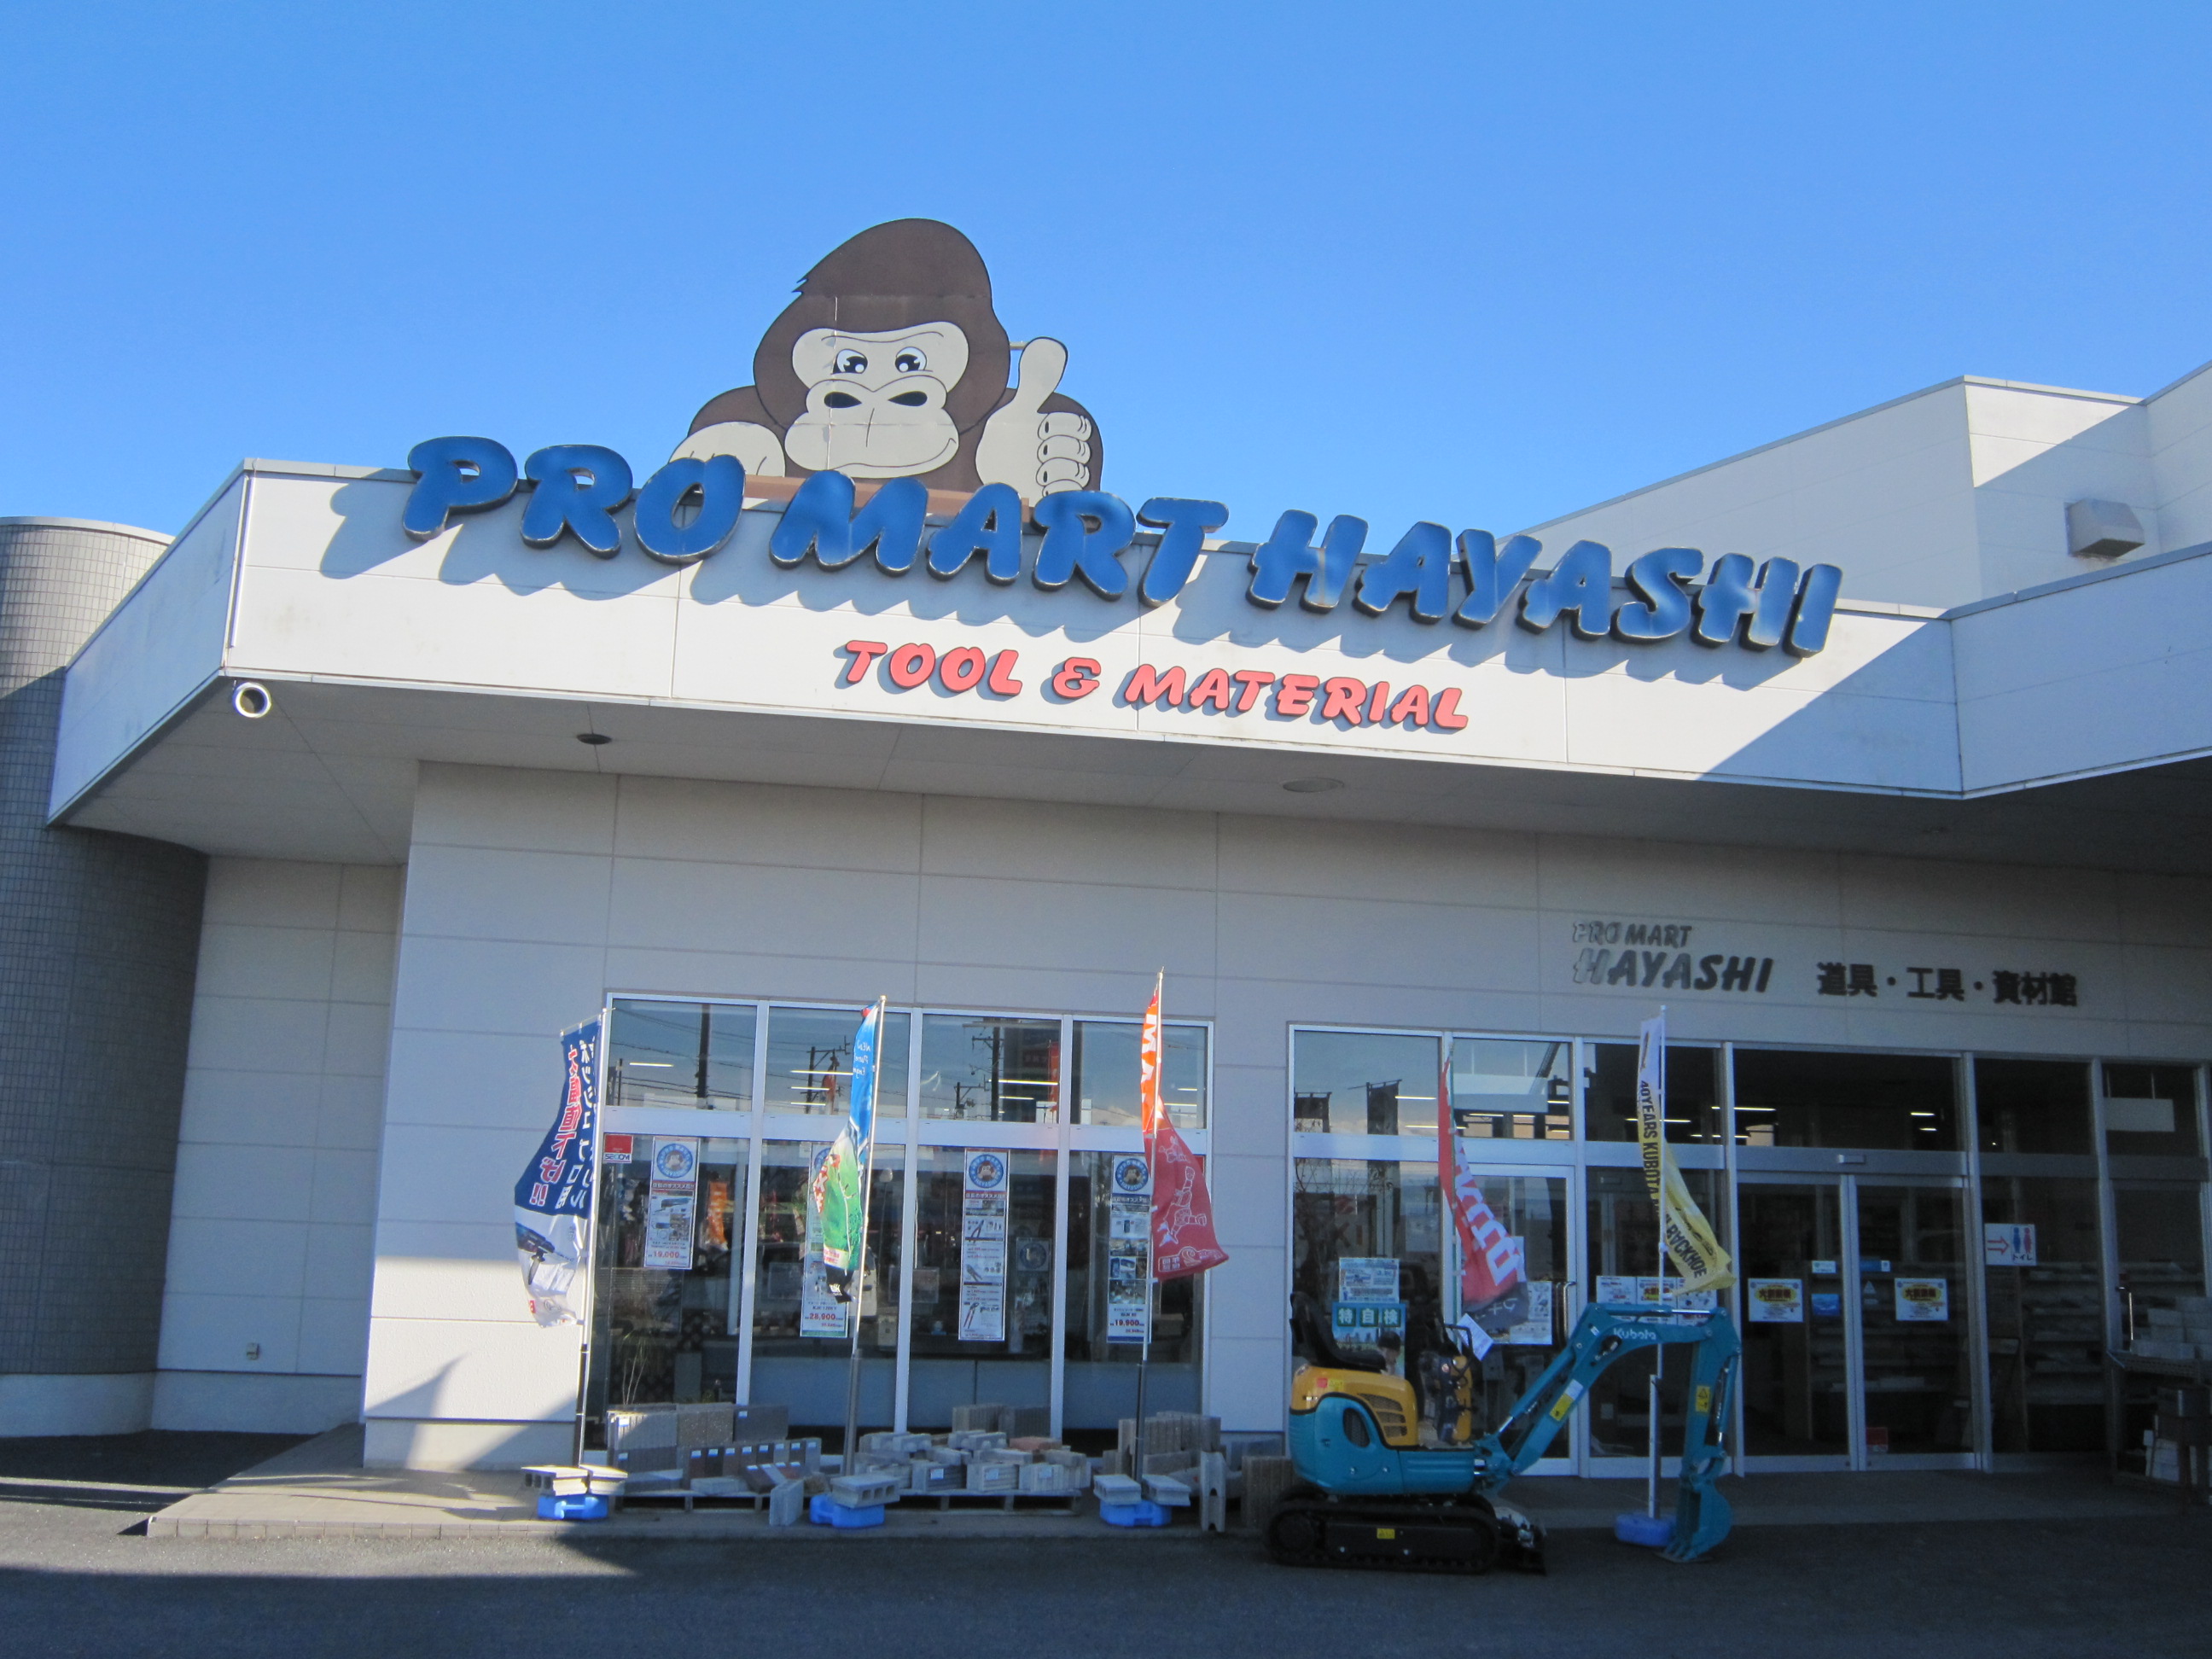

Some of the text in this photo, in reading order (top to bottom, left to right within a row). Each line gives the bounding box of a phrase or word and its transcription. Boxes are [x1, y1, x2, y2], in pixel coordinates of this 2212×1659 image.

[402, 435, 1843, 659] PRO MART HAYASHI
[843, 640, 1469, 731] TOOL & MATERIAL
[1573, 920, 1693, 949] PRO MART
[1573, 947, 1774, 993] HAYASHI
[1613, 1327, 1657, 1342] Kubota
